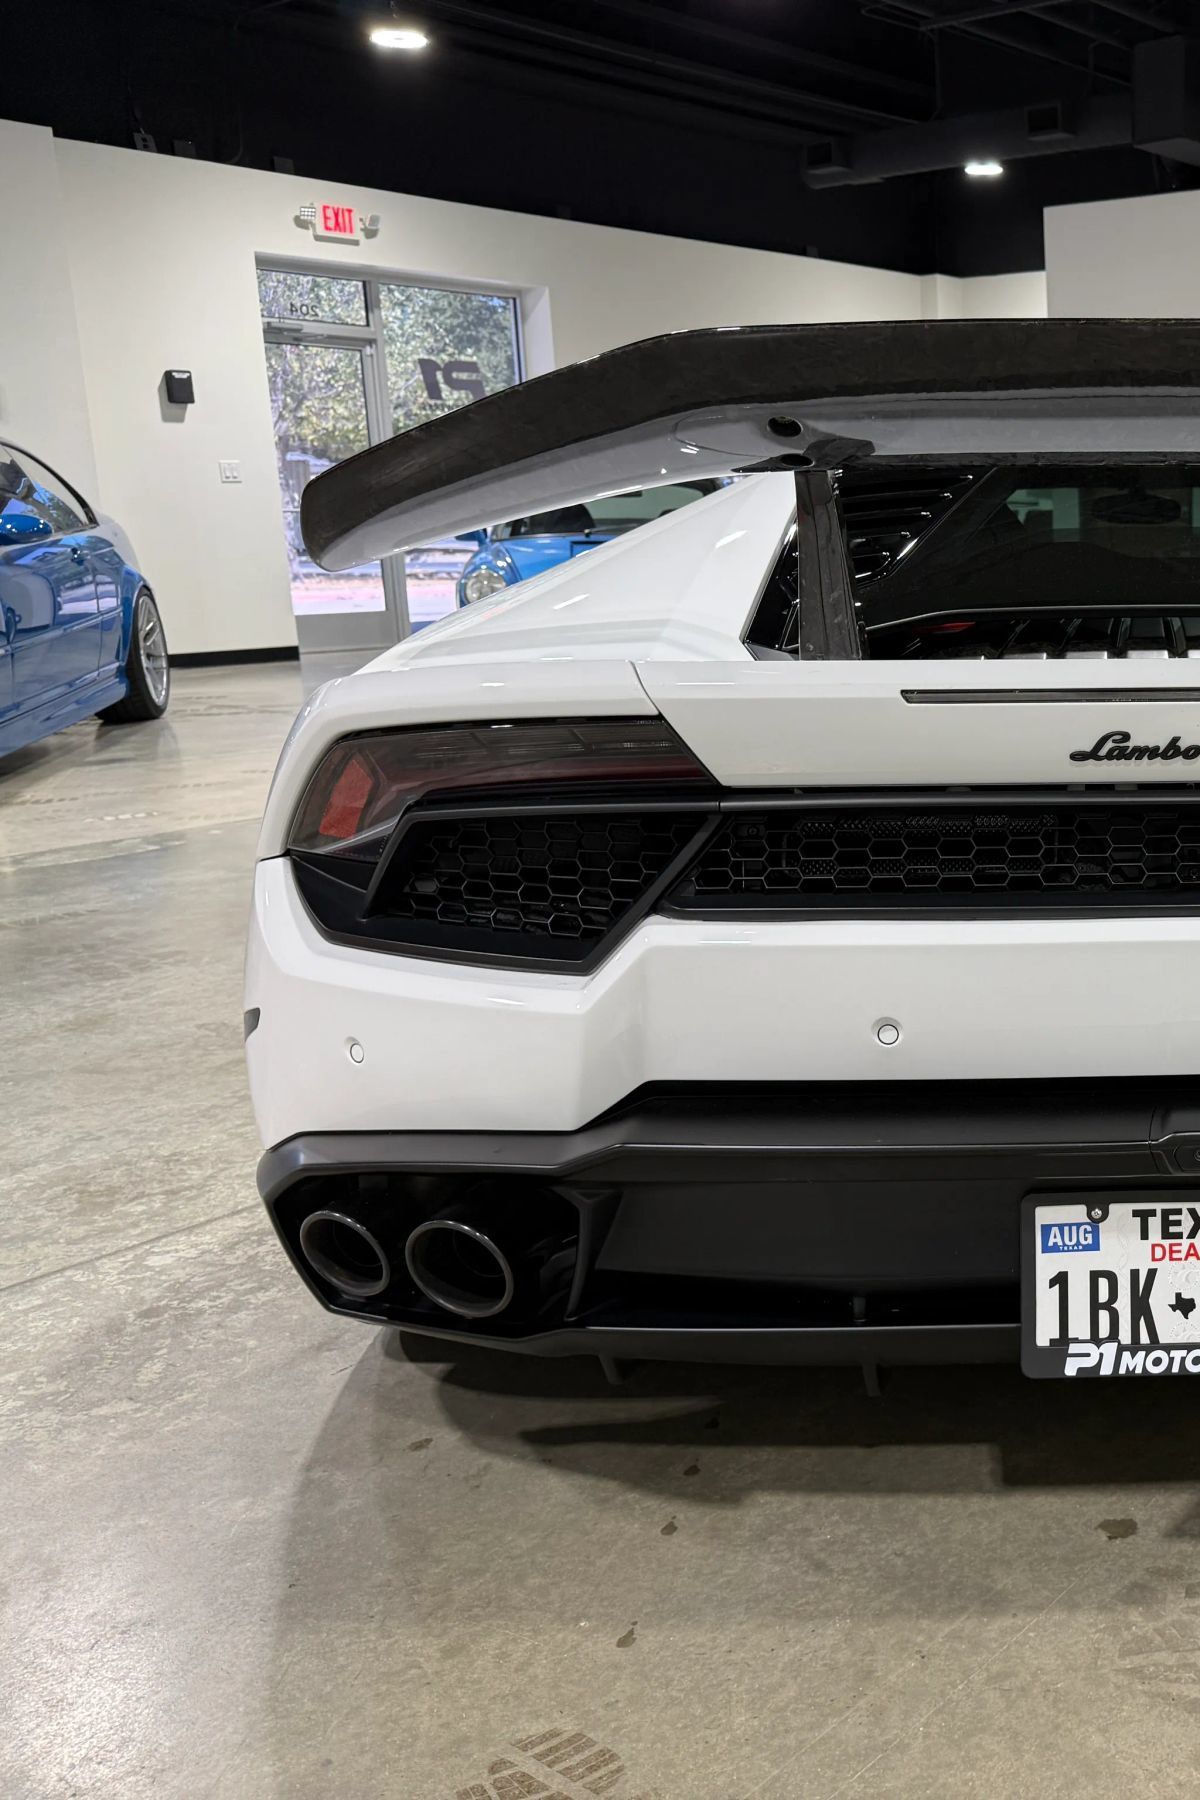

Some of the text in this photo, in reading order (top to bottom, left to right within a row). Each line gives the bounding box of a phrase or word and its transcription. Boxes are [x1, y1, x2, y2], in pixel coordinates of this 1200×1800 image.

[322, 205, 354, 234] EXIT
[1047, 1224, 1093, 1247] AUG
[1048, 1267, 1160, 1347] 1BK
[1064, 1342, 1119, 1376] P1
